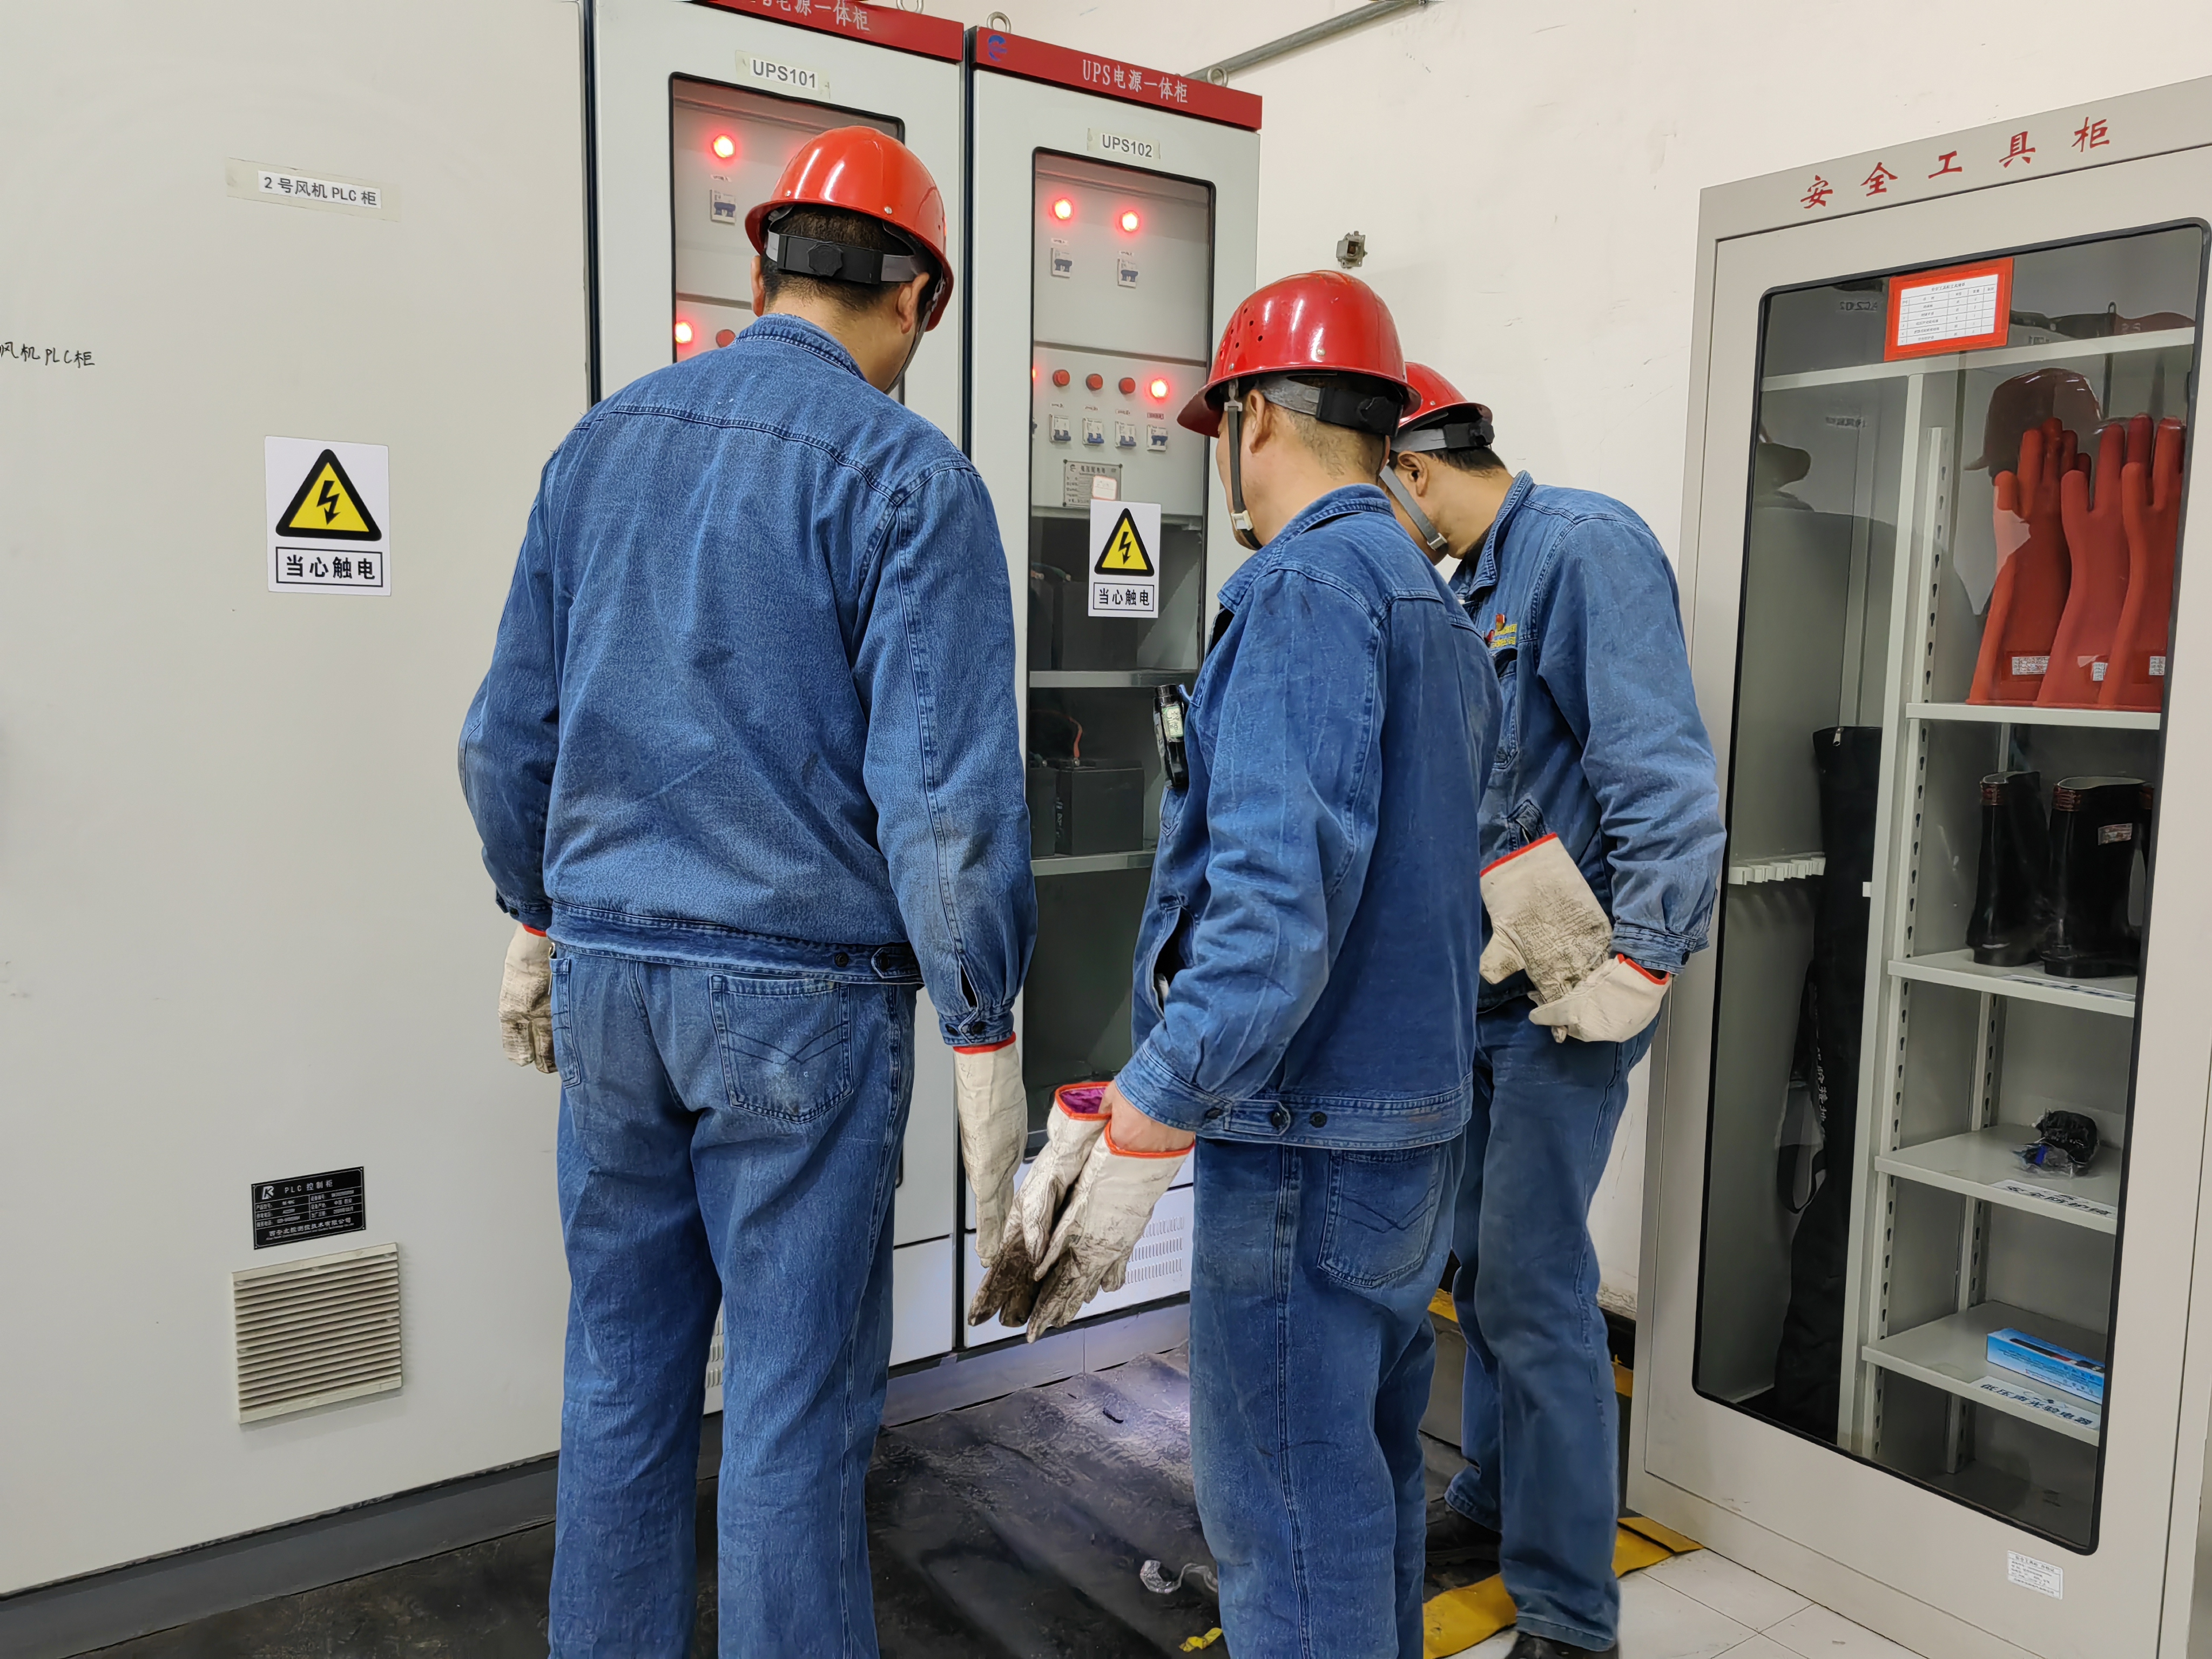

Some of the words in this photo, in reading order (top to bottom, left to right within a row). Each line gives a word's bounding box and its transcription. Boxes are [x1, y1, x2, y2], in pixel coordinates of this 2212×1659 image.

[753, 59, 815, 88] UPS101
[1083, 59, 1188, 104] UPS电源一体柜
[1102, 134, 1152, 158] UPS102
[1800, 116, 2110, 210] 安全工具柜
[286, 554, 376, 581] 当心触电
[1098, 588, 1150, 606] 当心触电
